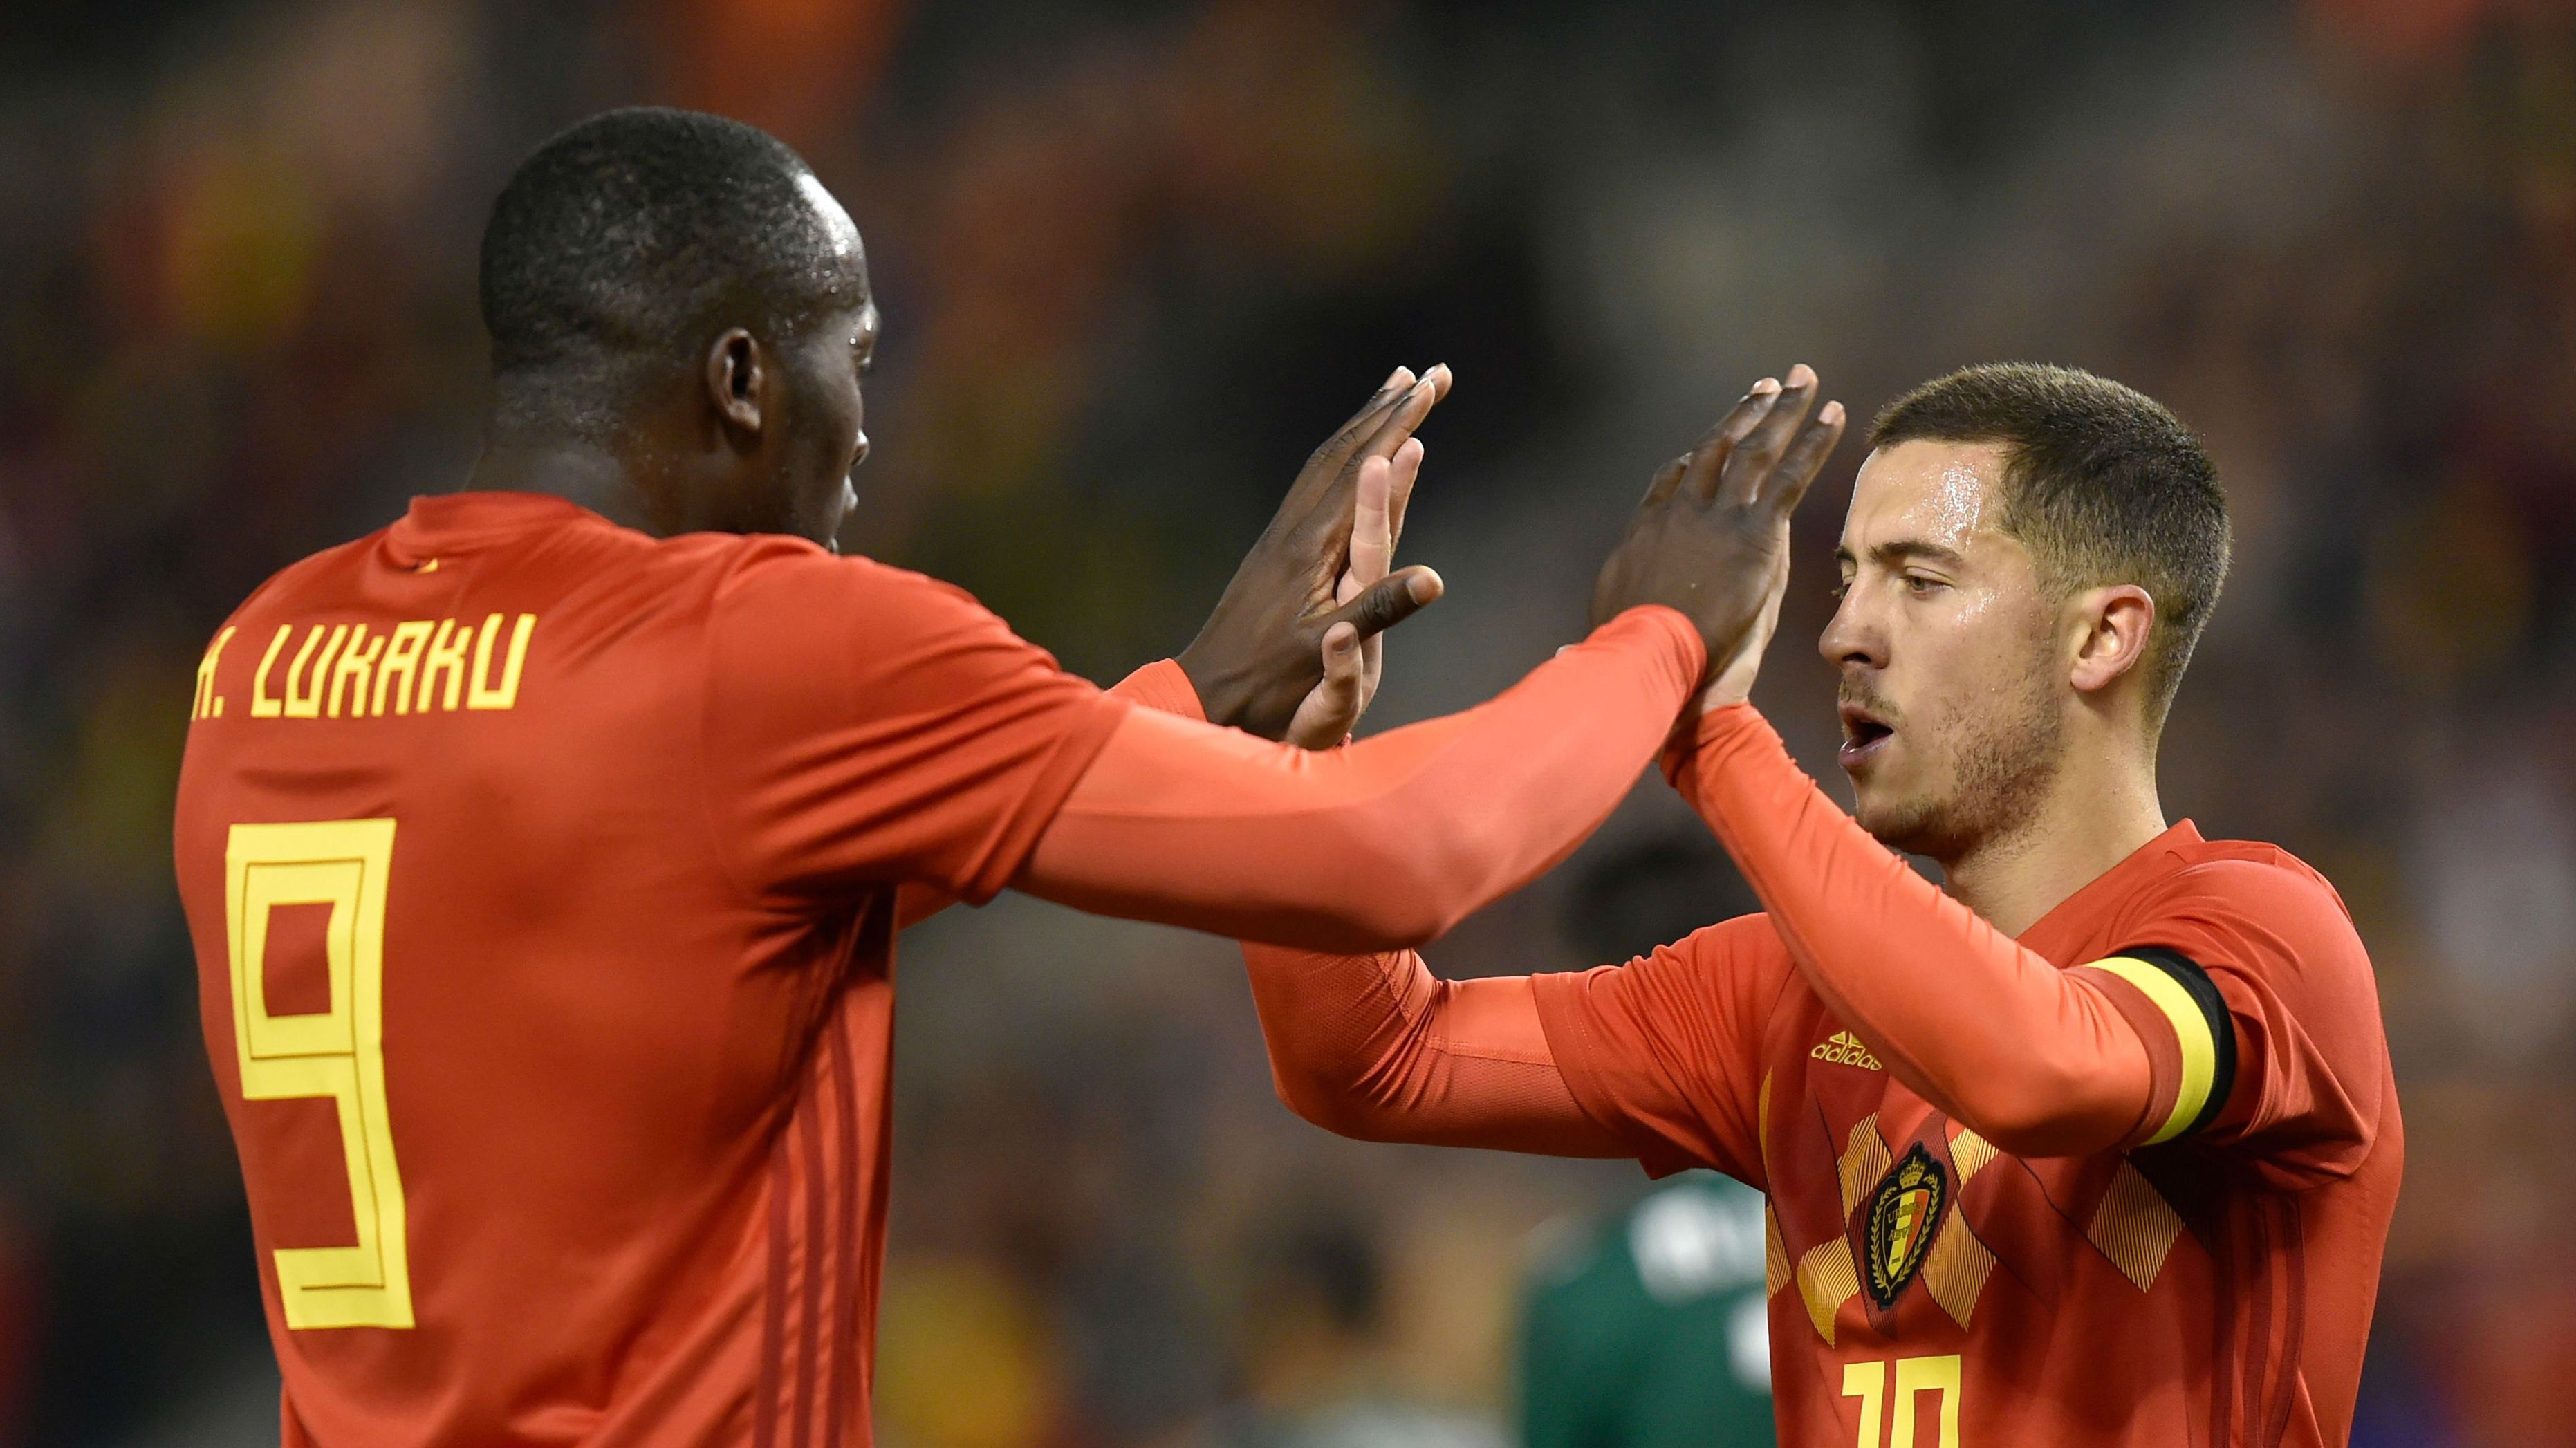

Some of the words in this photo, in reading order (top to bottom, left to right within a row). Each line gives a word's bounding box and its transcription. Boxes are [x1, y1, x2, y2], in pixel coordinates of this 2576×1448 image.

[251, 613, 537, 718] LUKAKU
[226, 818, 415, 1329] 9
[1811, 1043, 1882, 1070] adidas
